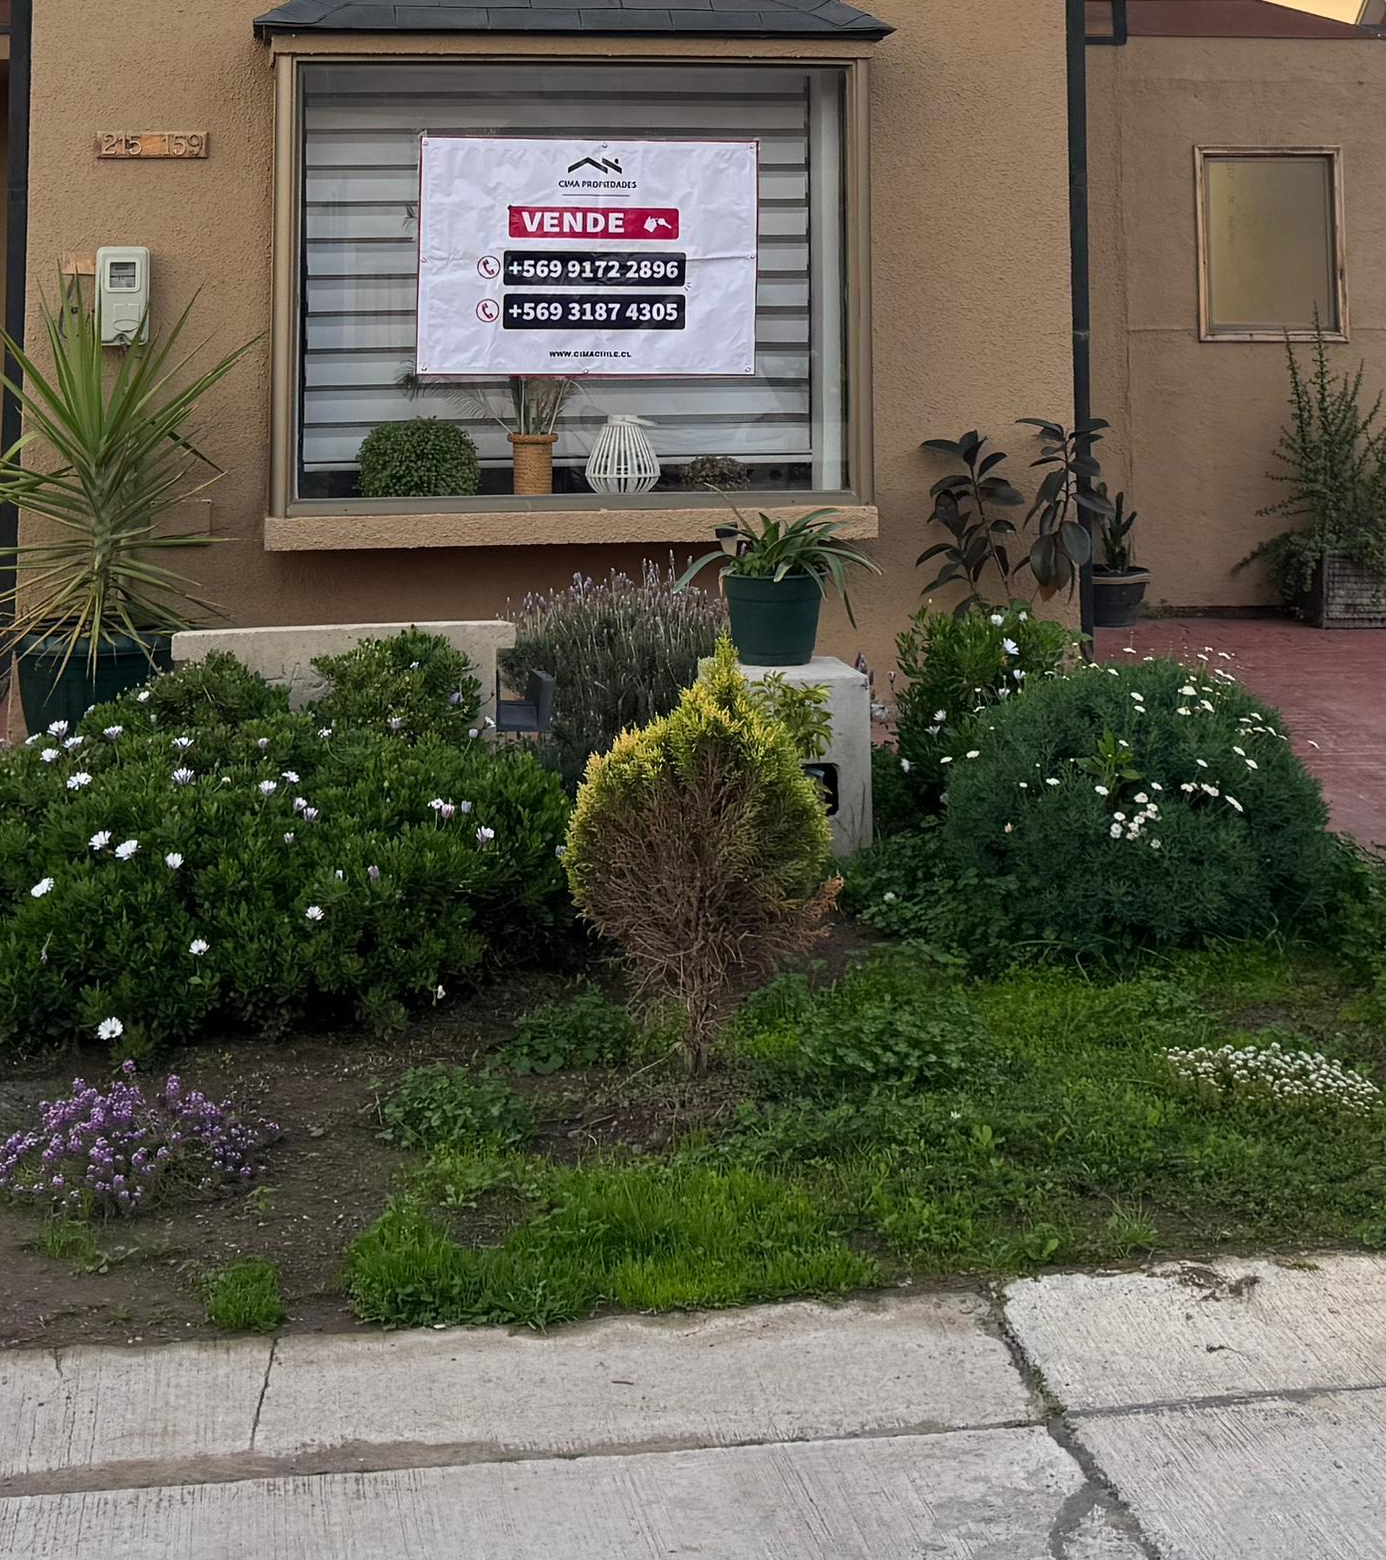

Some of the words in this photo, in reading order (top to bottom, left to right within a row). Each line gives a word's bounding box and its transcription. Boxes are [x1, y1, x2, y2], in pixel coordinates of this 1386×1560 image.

[521, 211, 625, 233] VENDE
[509, 260, 563, 278] +569
[567, 261, 621, 278] 9172
[625, 261, 680, 279] 2896
[509, 302, 563, 321] +569
[567, 303, 620, 321] 3187
[625, 303, 679, 321] 4305
